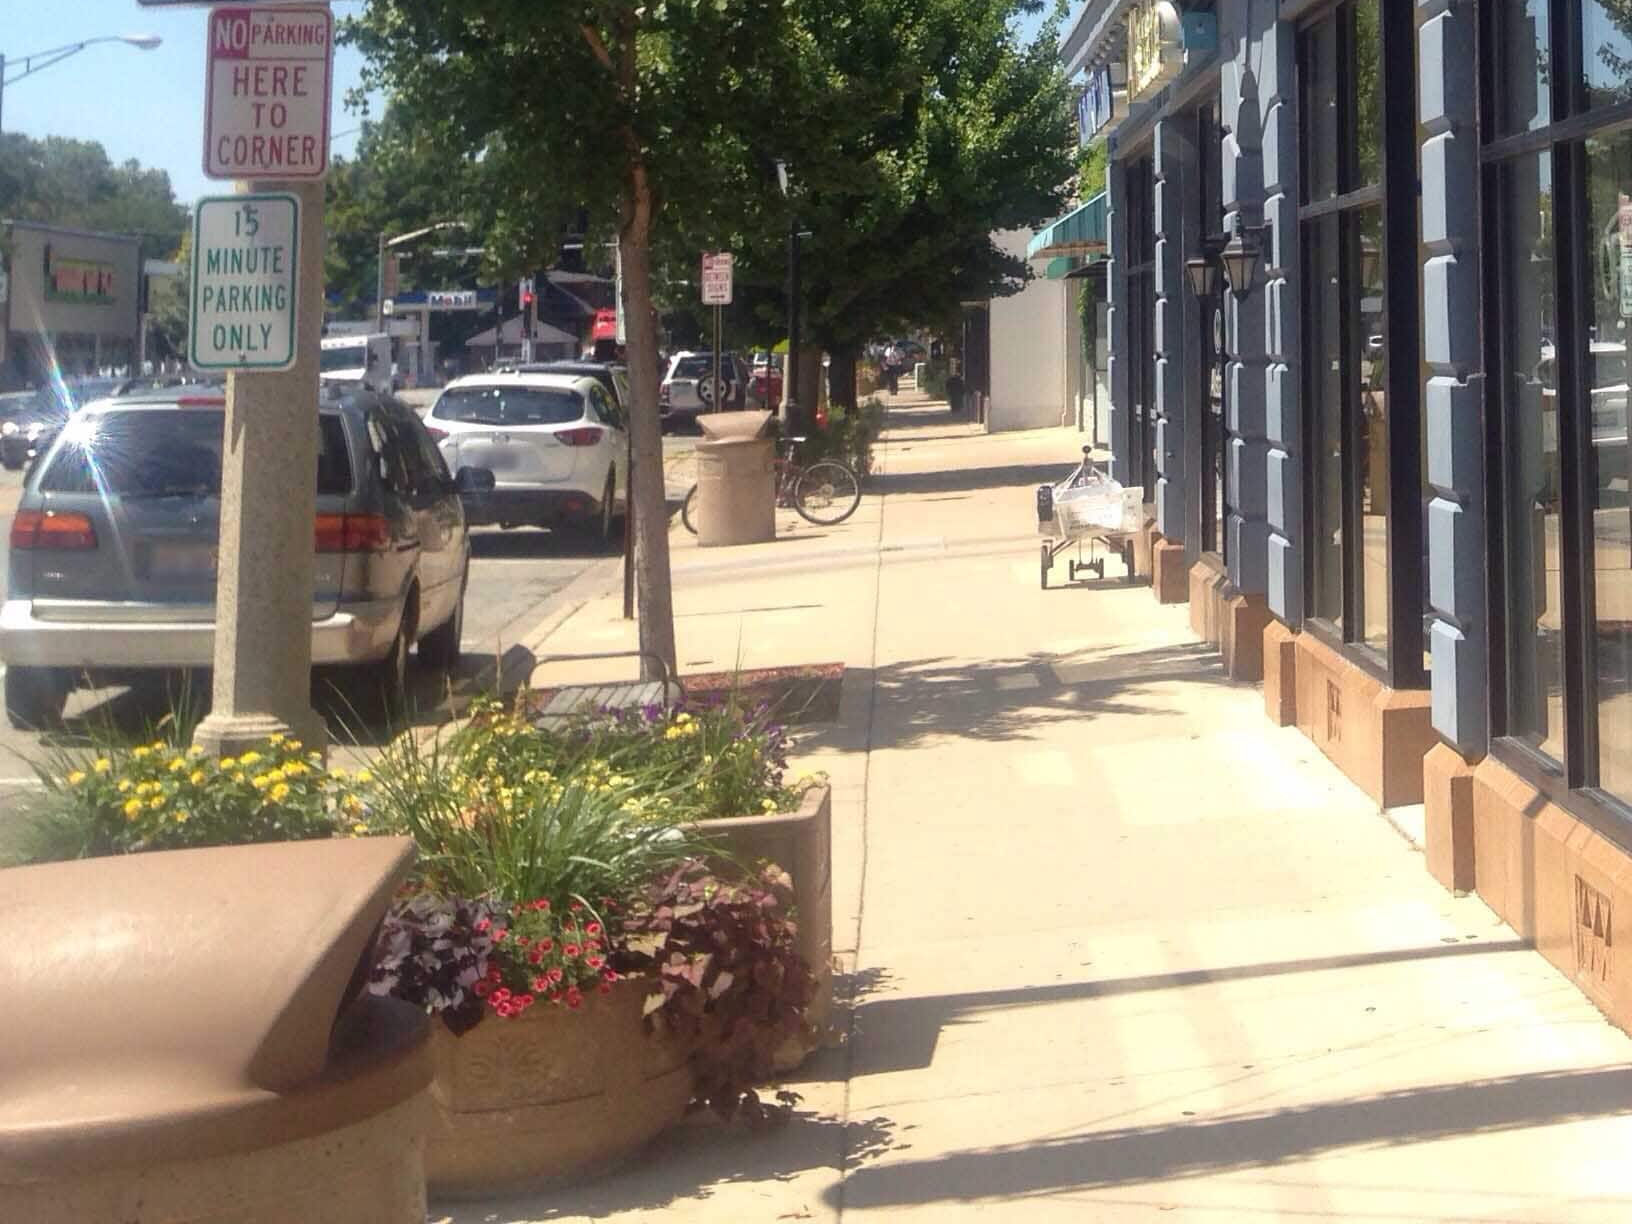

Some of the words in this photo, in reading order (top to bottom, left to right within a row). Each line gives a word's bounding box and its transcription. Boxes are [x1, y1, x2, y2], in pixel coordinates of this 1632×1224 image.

[215, 19, 246, 51] NO
[251, 23, 325, 45] PARKING
[232, 66, 308, 97] HERE
[252, 103, 288, 128] TO
[217, 135, 316, 166] CORNER
[235, 208, 259, 237] 15
[207, 246, 284, 275] MINUTE
[203, 284, 286, 313] PARKING
[213, 323, 272, 352] ONLY
